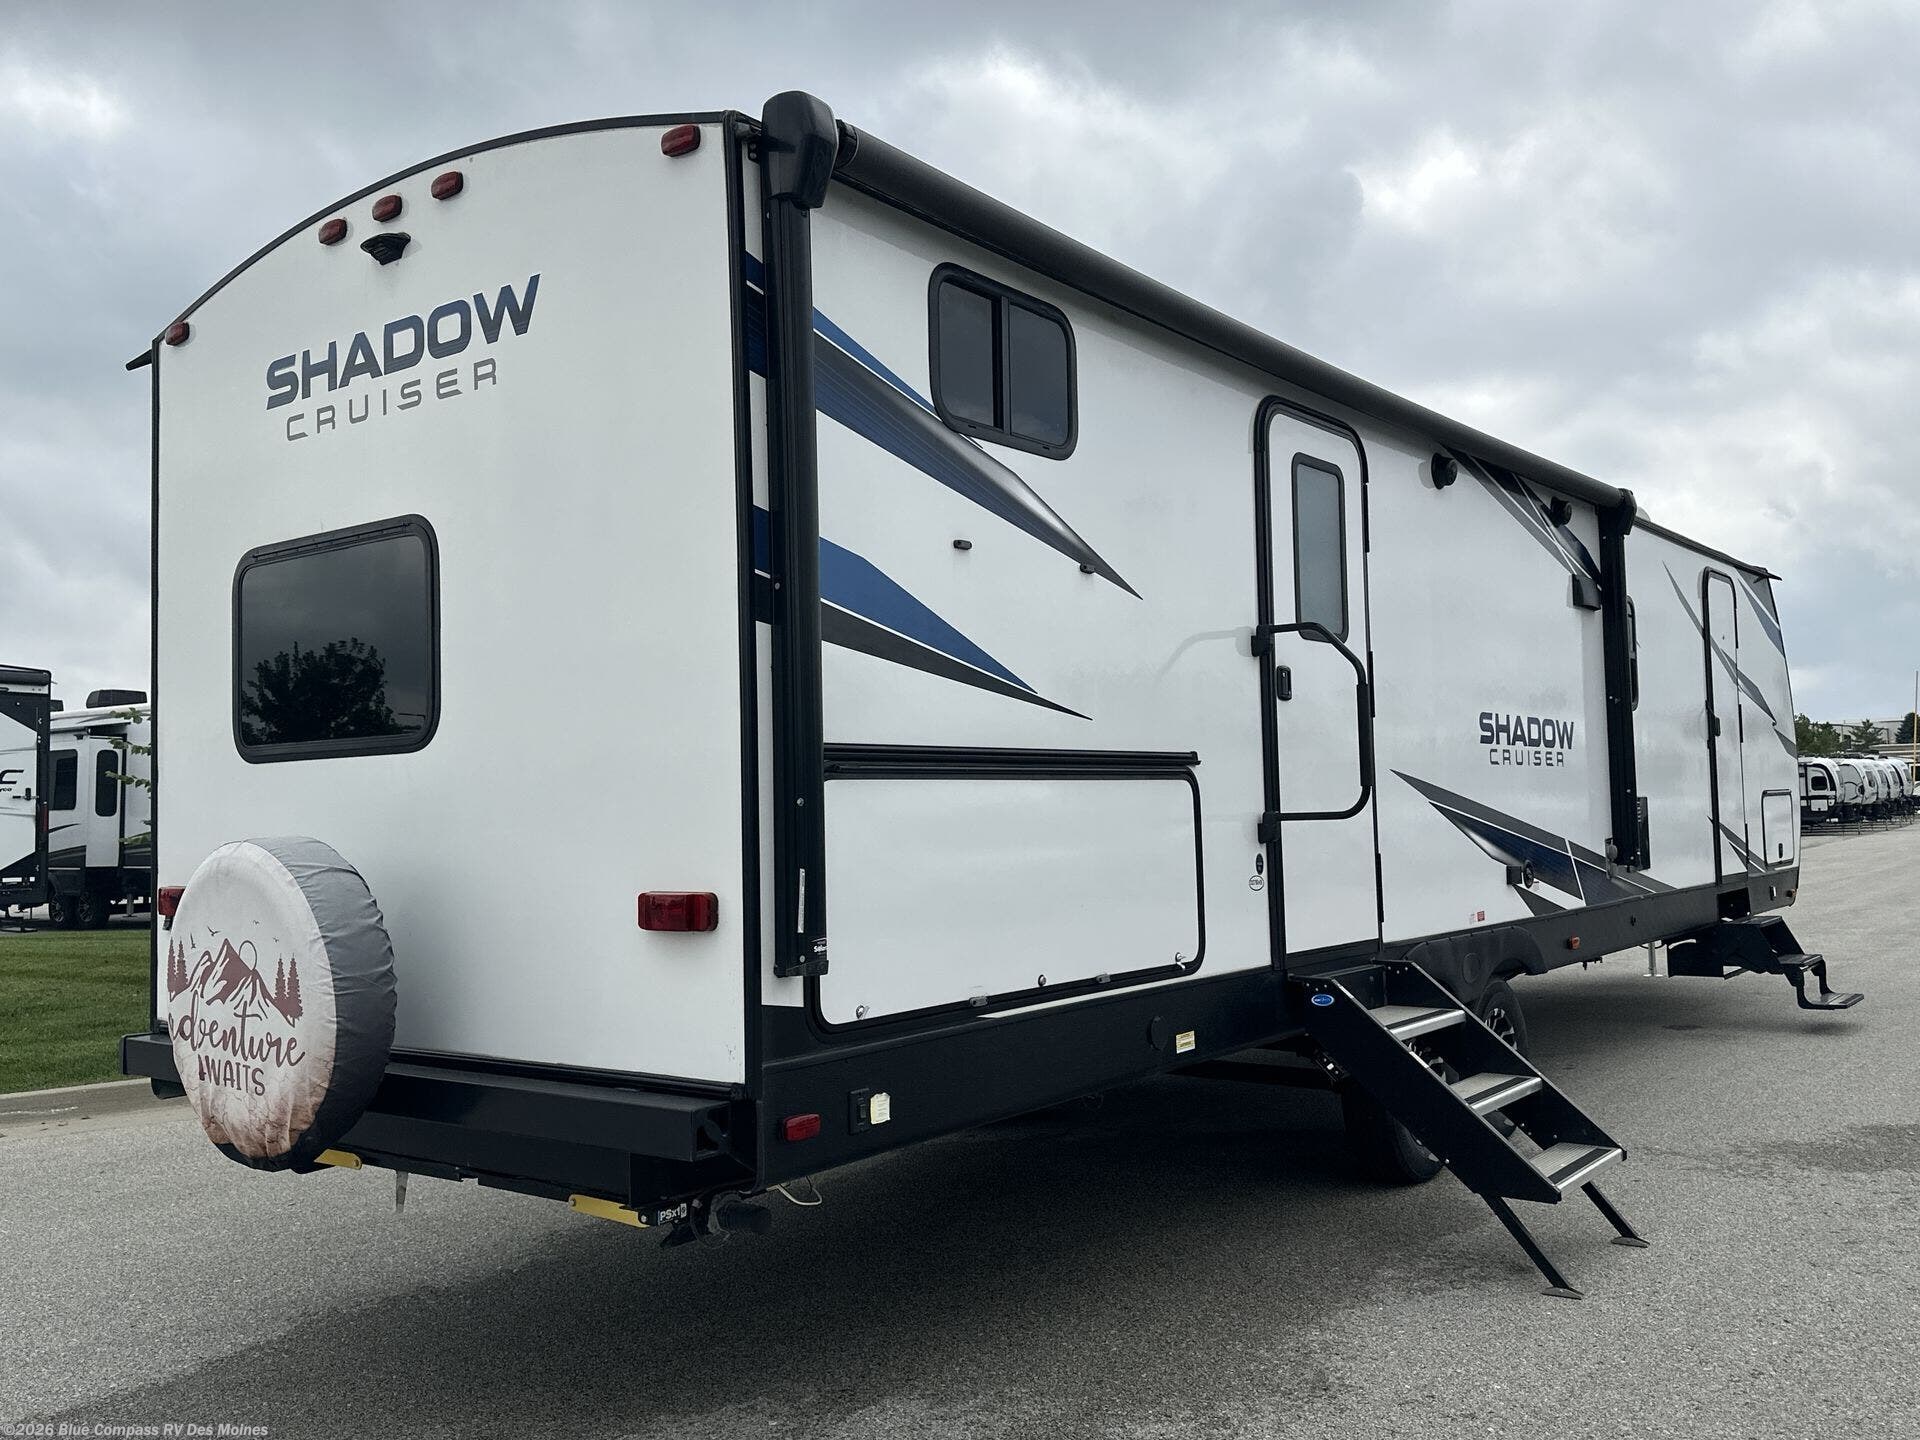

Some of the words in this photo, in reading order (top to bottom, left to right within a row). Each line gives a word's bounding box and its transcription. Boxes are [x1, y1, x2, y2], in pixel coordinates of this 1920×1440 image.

[266, 273, 541, 411] SHADOW
[286, 357, 498, 442] CRUISER
[1479, 711, 1574, 750] SHADOW
[1489, 748, 1564, 767] CRUISER
